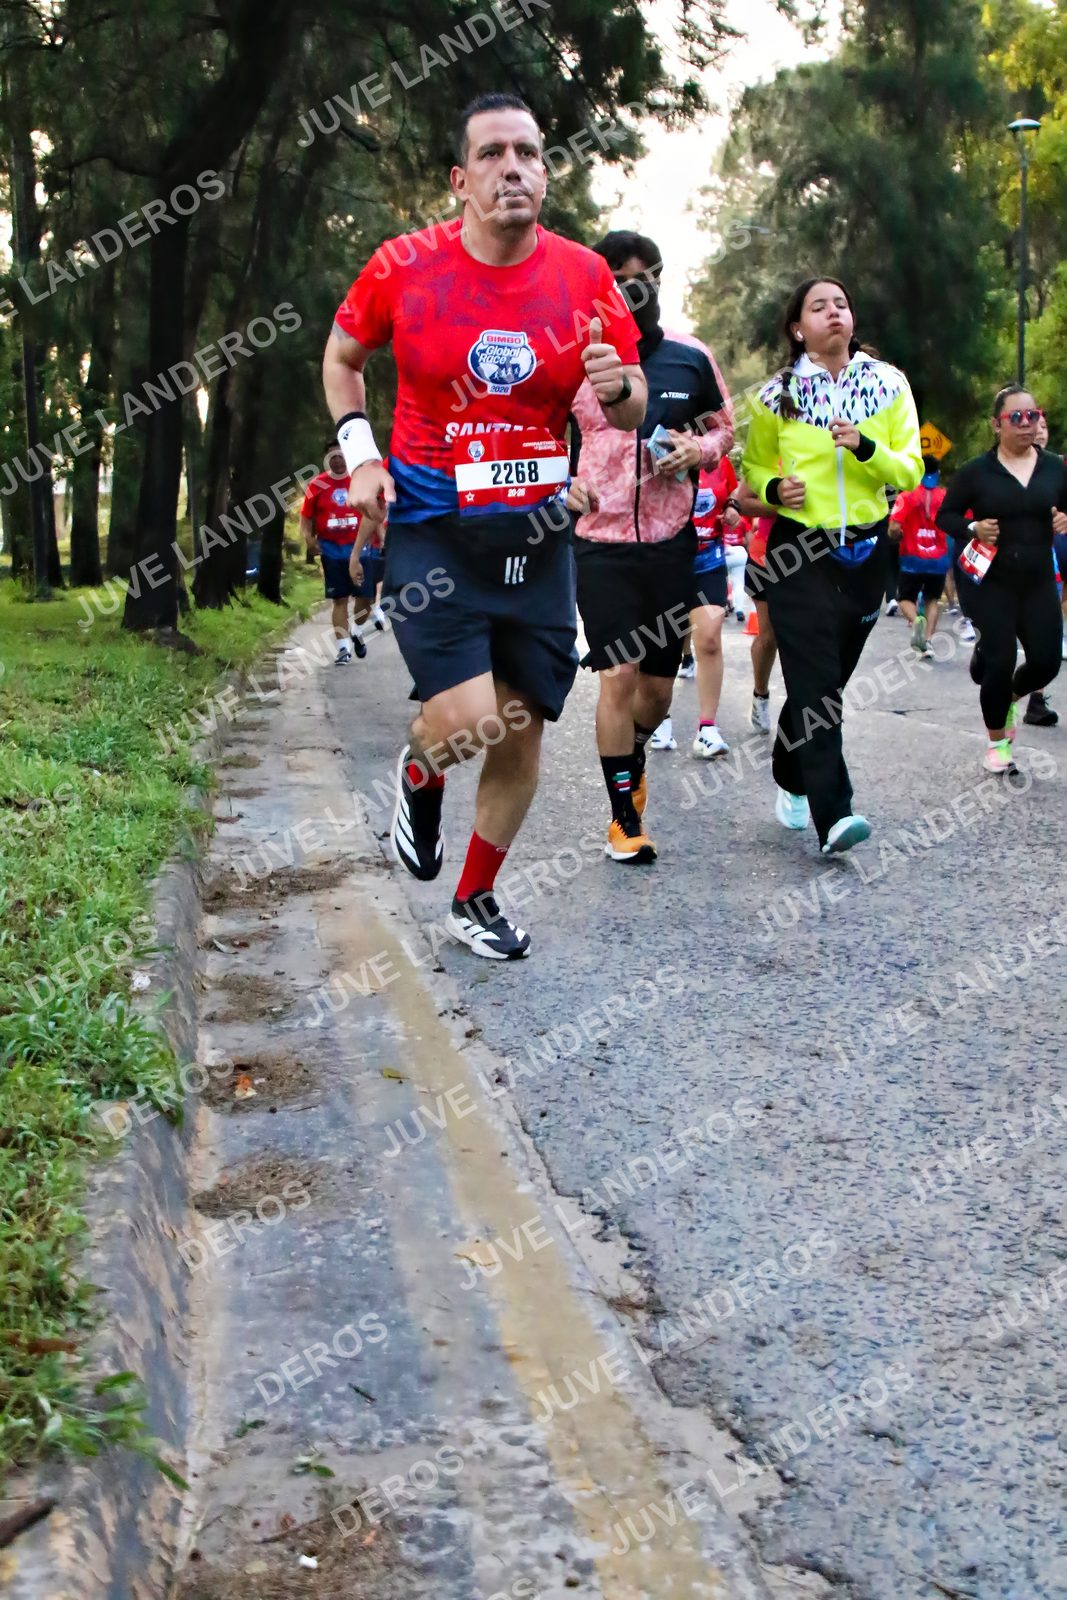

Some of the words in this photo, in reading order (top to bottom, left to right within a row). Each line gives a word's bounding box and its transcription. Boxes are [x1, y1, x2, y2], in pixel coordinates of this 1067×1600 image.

[486, 336, 521, 344] BIMBO
[486, 345, 521, 358] Global
[478, 353, 507, 365] Race
[445, 422, 549, 442] SANT
[491, 460, 539, 486] 2268
